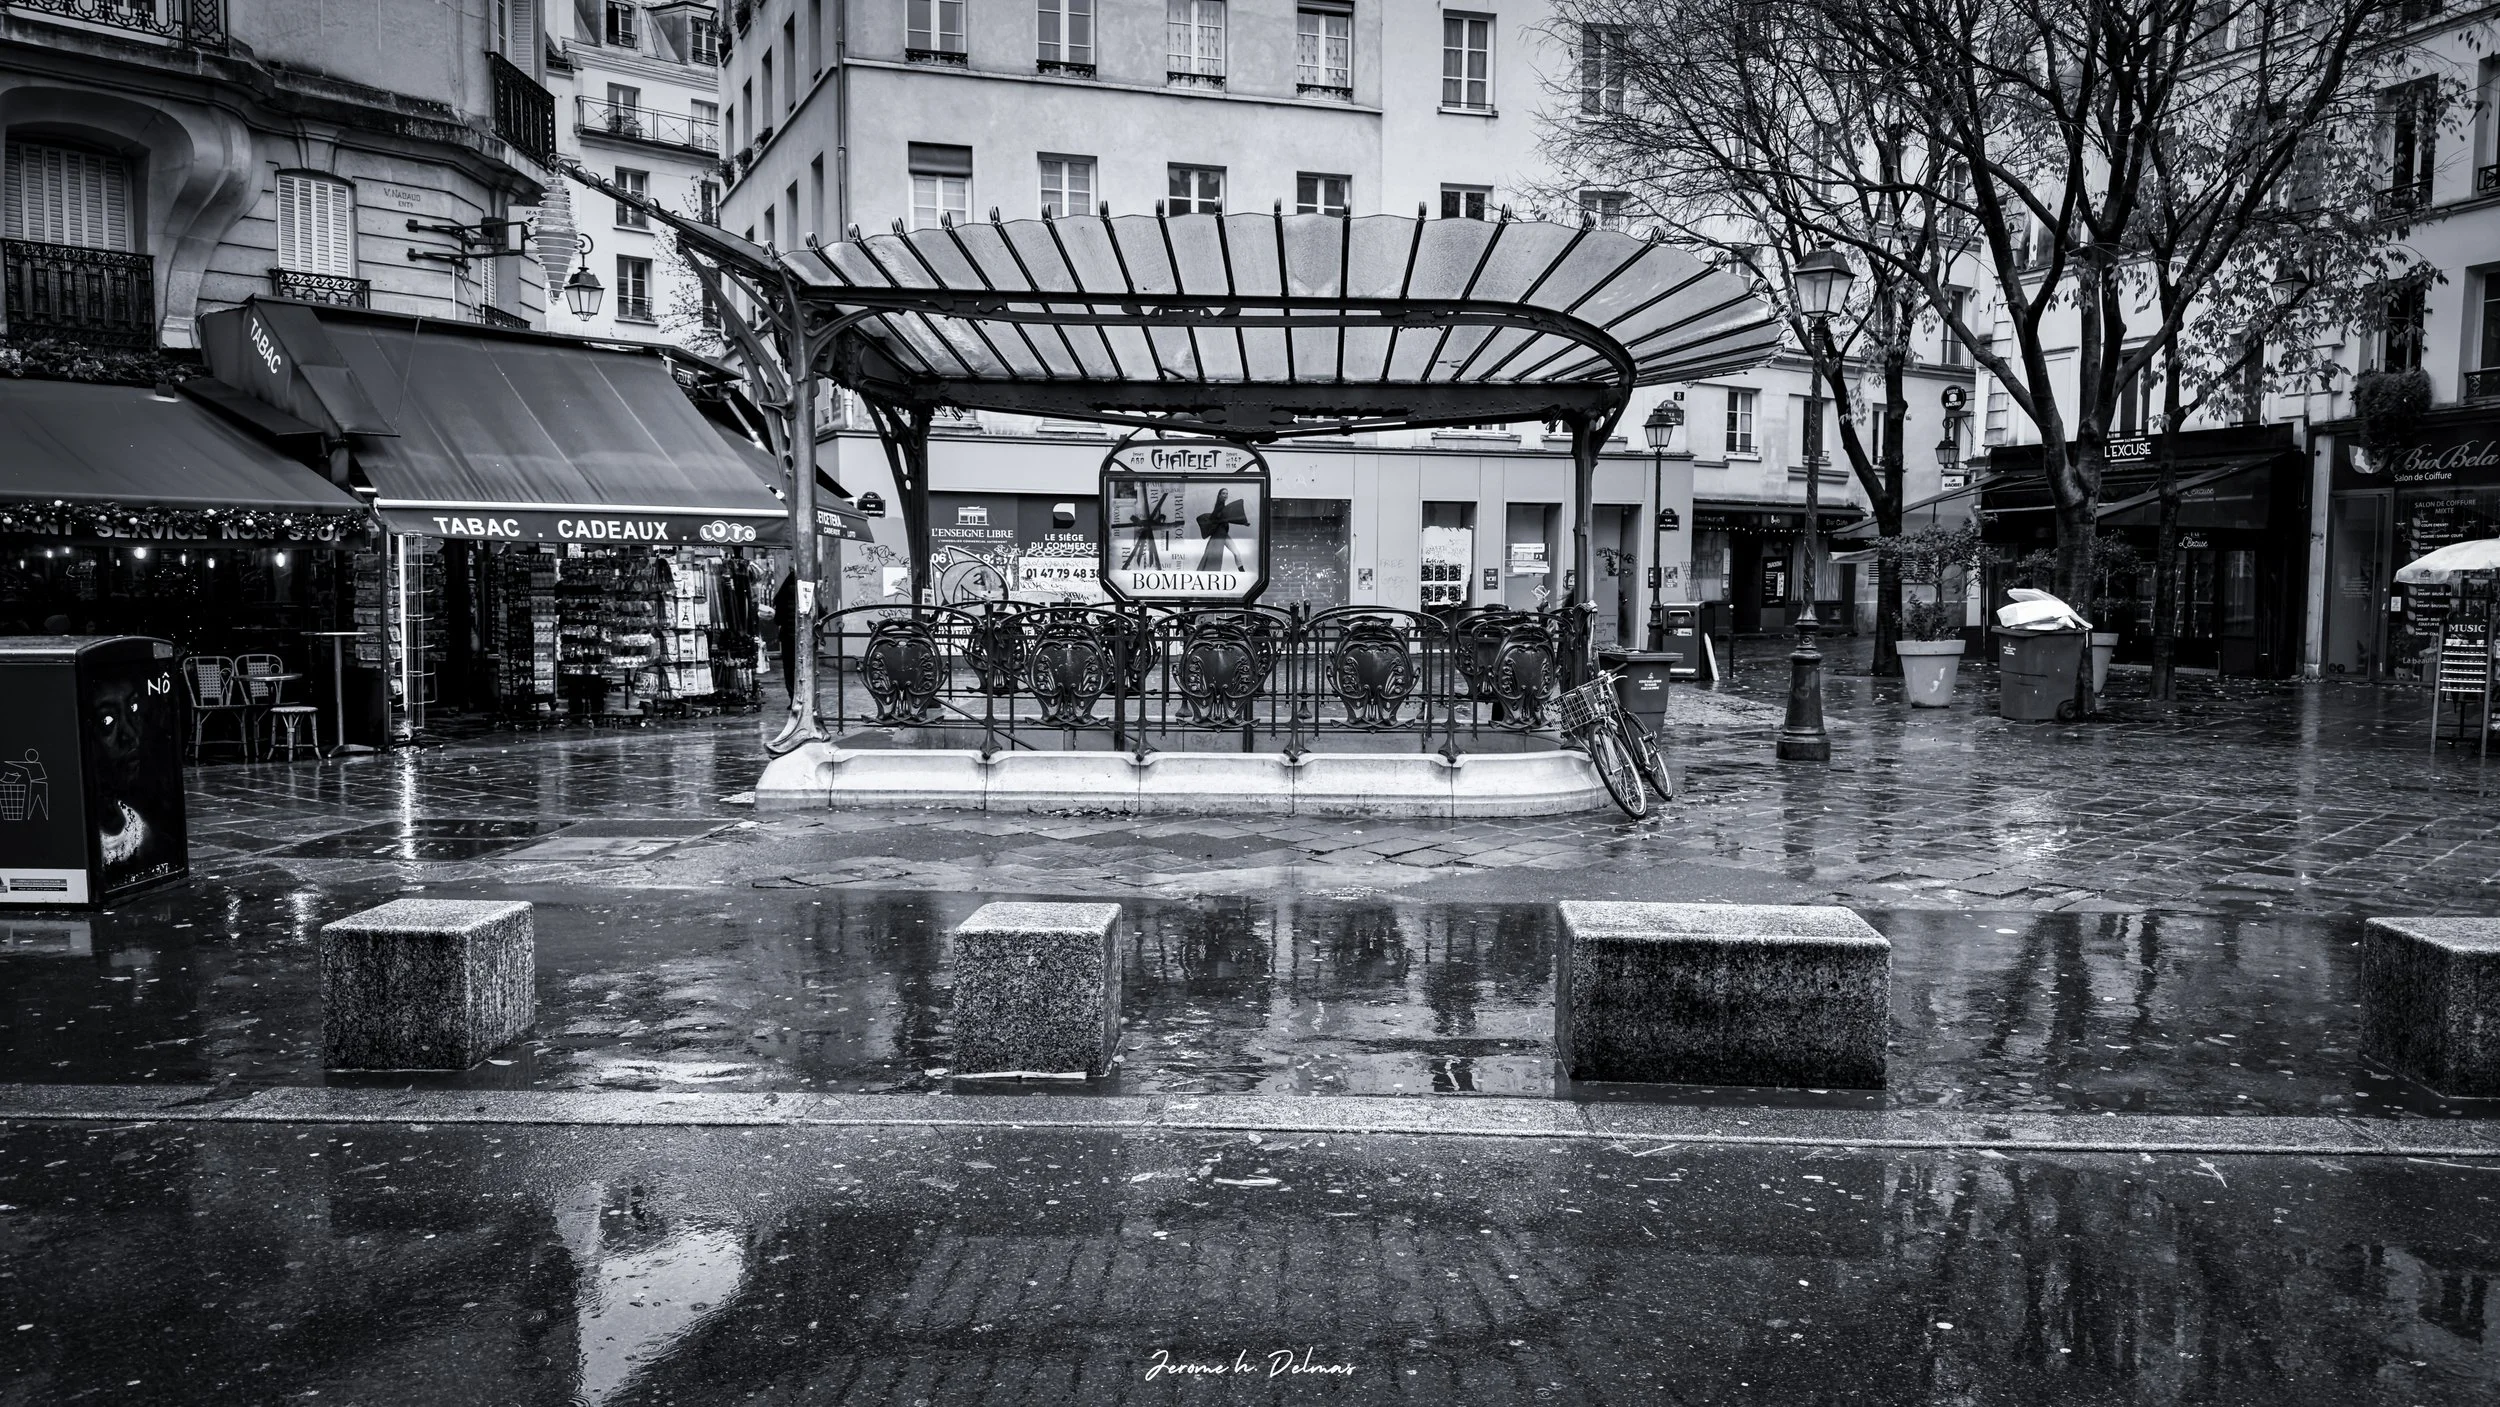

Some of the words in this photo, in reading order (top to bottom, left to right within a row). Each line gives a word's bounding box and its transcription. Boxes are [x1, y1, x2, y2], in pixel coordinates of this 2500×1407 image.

[250, 317, 281, 374] TABAC
[2104, 442, 2152, 458] L'EXCUSE
[2394, 473, 2413, 482] Salon
[2414, 473, 2423, 481] de
[2424, 472, 2452, 481] Coiffure
[2414, 500, 2435, 508] SALON
[2445, 498, 2477, 507] COIFFURE
[433, 517, 521, 538] TABAC
[557, 520, 668, 541] CADEAUX
[931, 528, 984, 538] L'ENSEIGNE
[986, 529, 1014, 539] LIBRE
[1045, 533, 1056, 542] LE
[1058, 532, 1084, 542] SIÈGE
[1031, 542, 1043, 550] DU
[1046, 542, 1098, 551] COMMERCE
[931, 553, 946, 564] 06
[1026, 568, 1037, 578] 01
[1040, 568, 1054, 579] 47
[1056, 568, 1070, 579] 79
[1073, 568, 1086, 579] 48
[1132, 572, 1237, 592] BOMPARD
[2448, 624, 2486, 633] MUSIC
